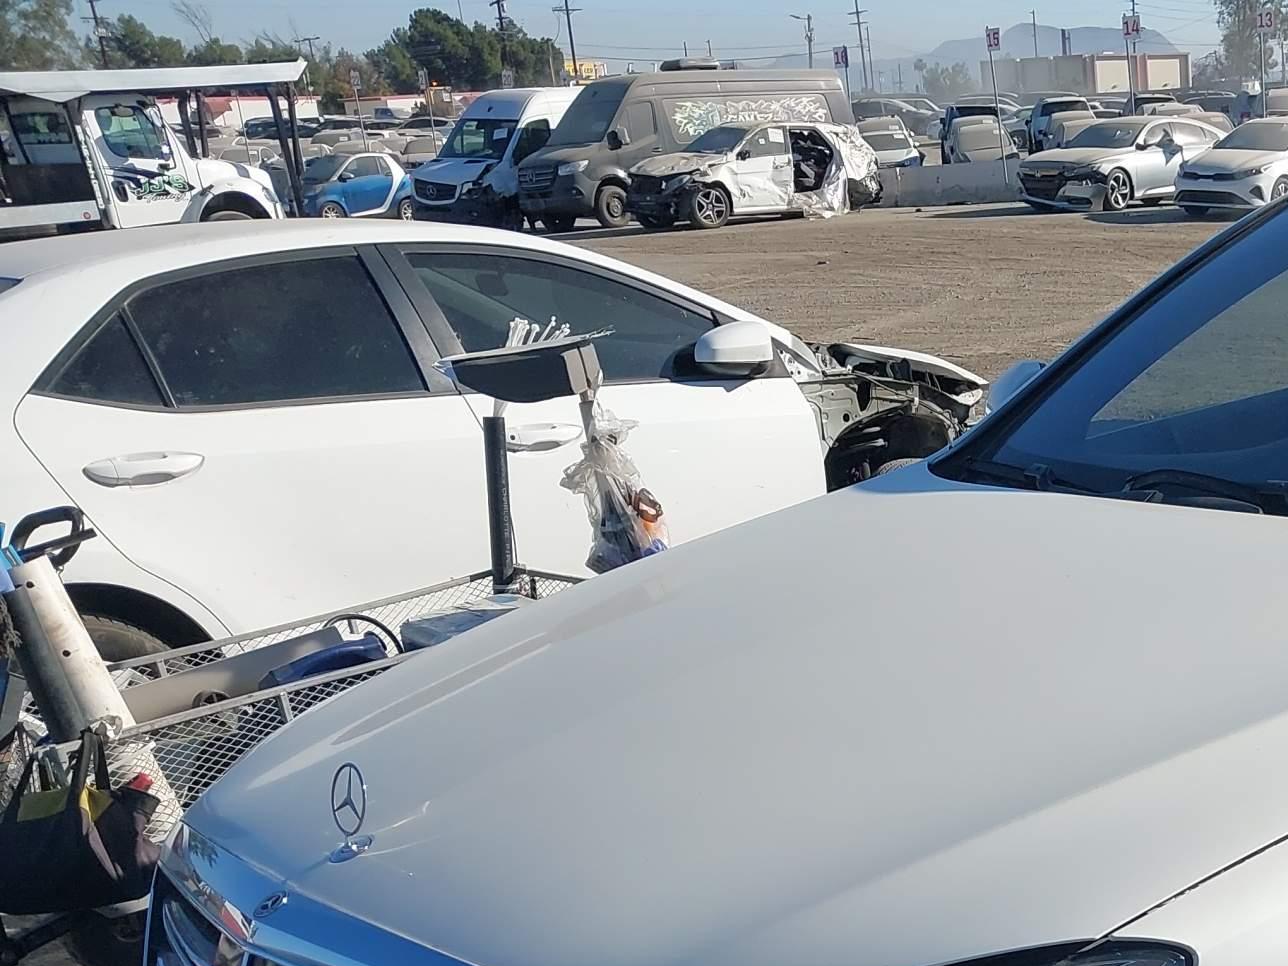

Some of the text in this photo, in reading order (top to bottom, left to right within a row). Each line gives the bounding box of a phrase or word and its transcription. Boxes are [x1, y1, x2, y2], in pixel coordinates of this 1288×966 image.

[1123, 19, 1139, 35] 14
[1257, 11, 1273, 28] 13
[986, 31, 1000, 47] 15
